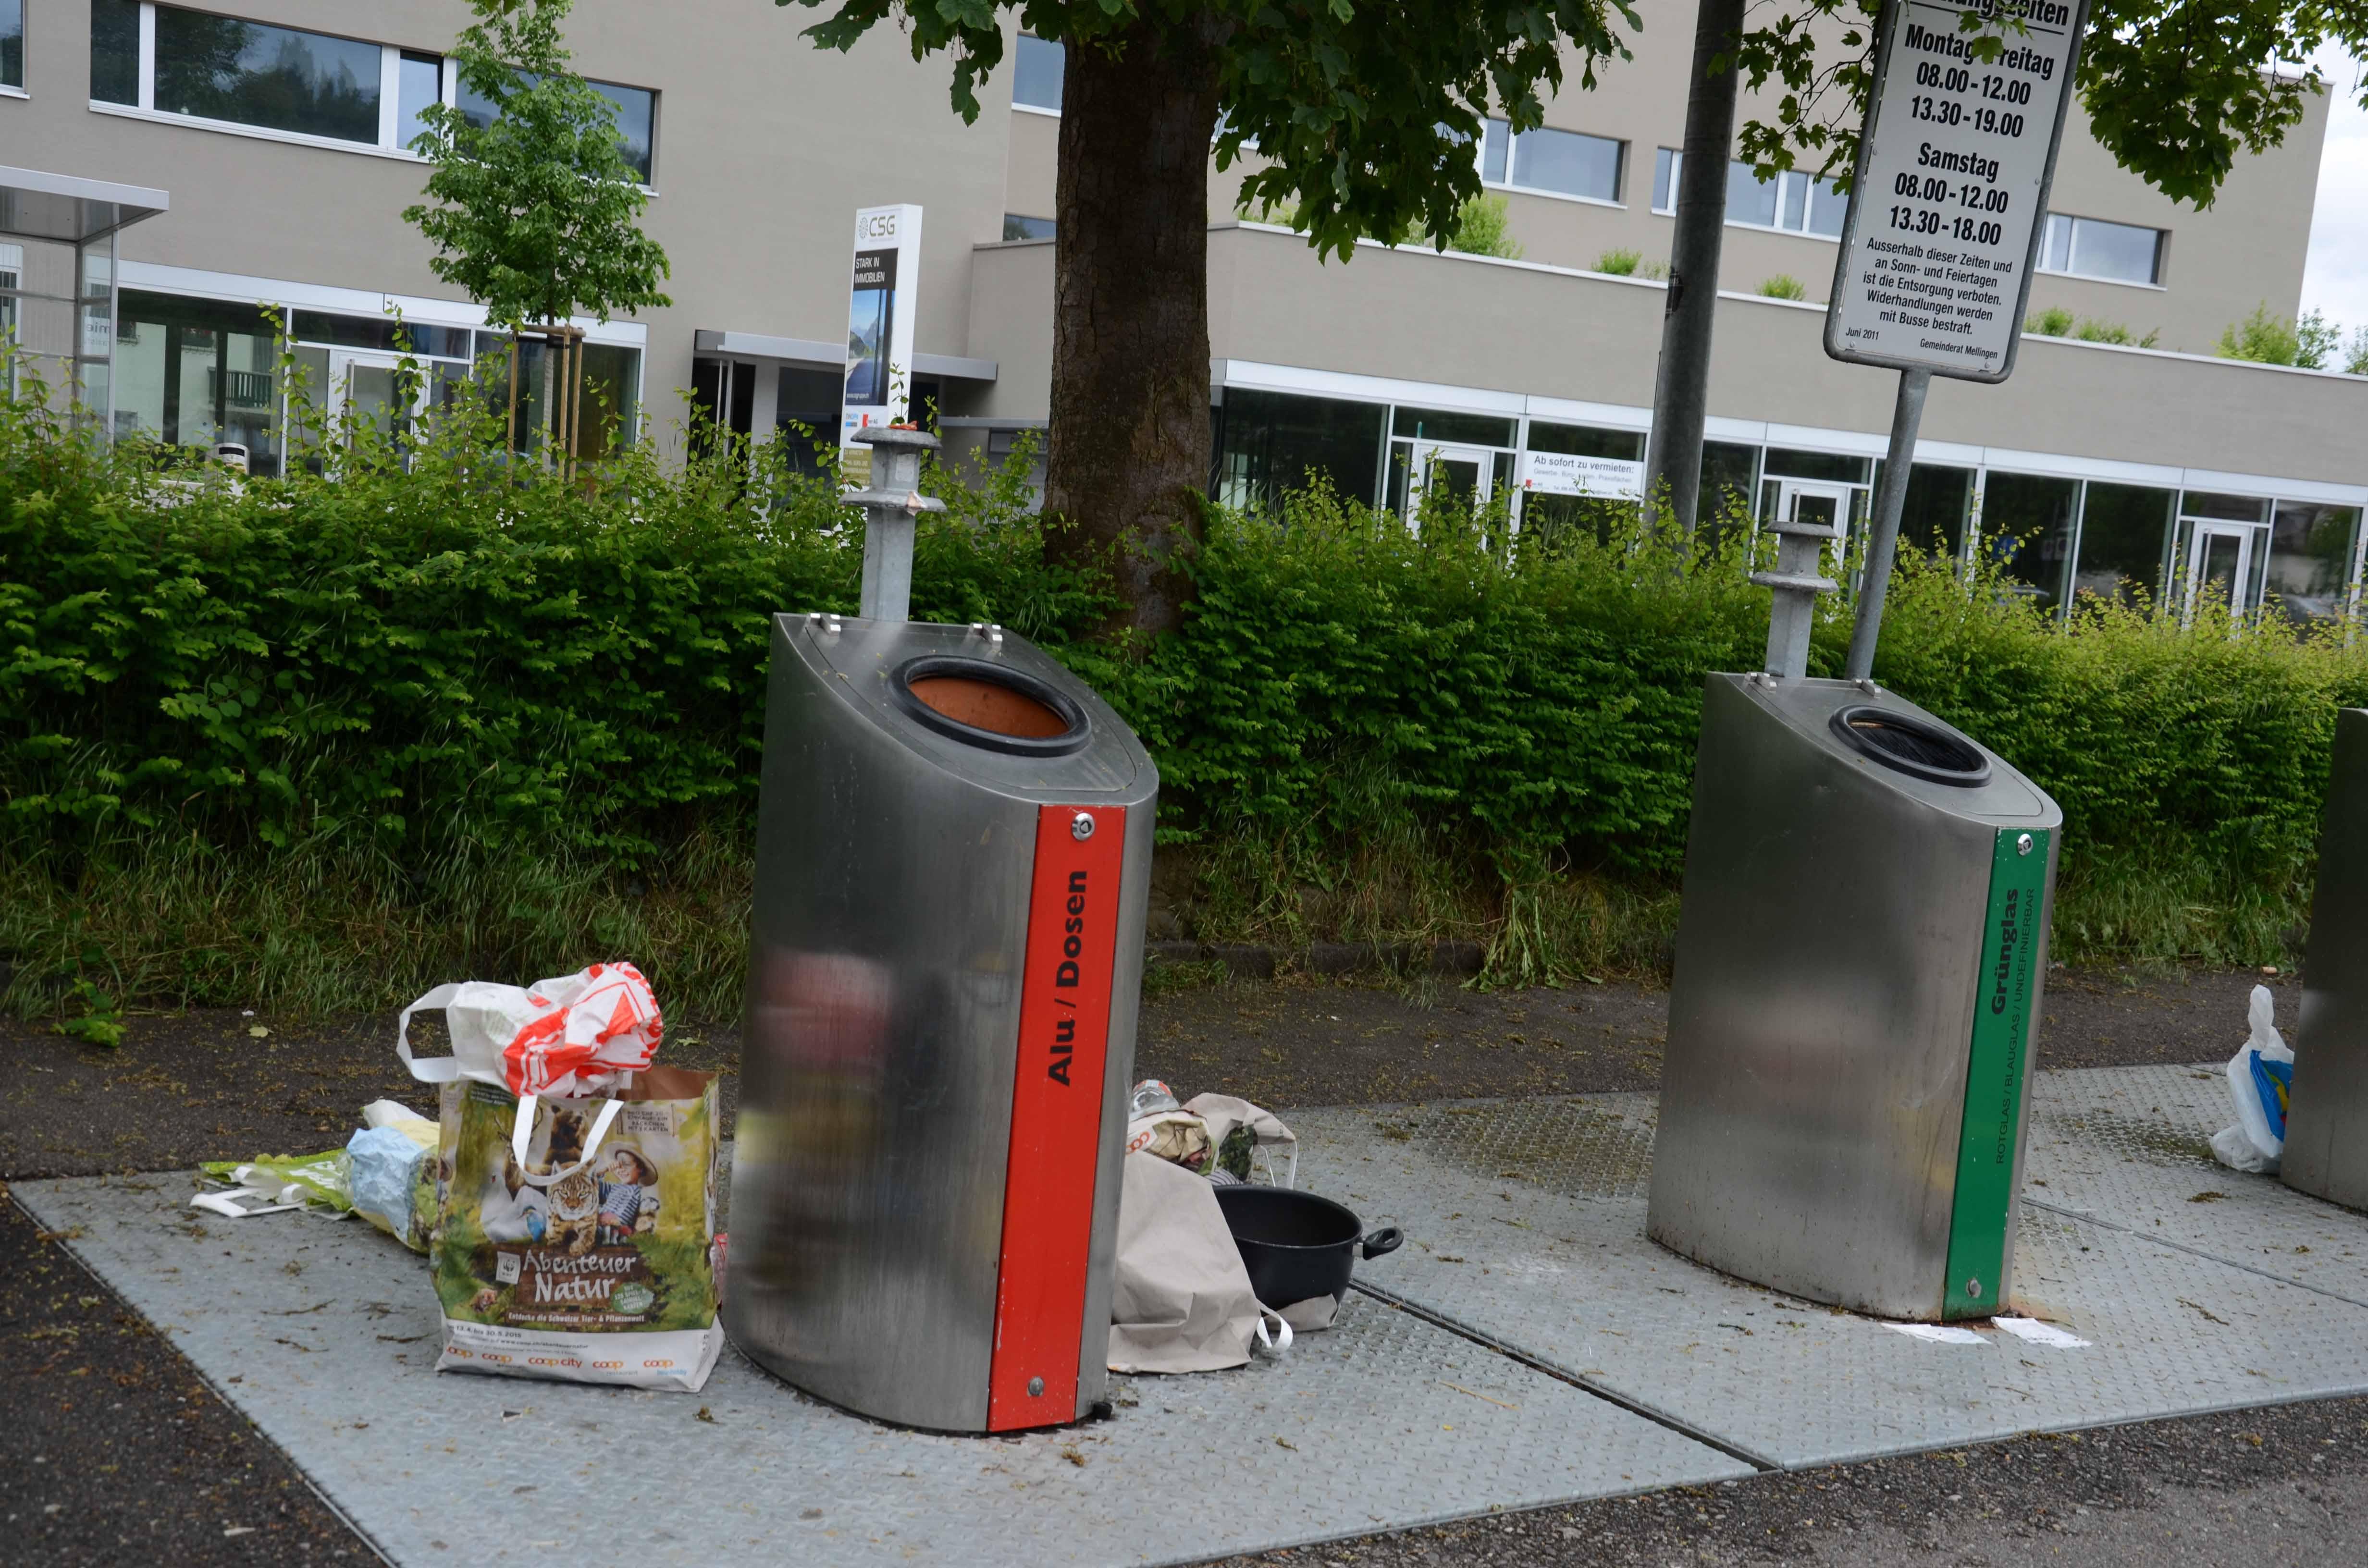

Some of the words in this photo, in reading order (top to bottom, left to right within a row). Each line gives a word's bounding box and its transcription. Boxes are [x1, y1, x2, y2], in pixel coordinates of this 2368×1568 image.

[1905, 24, 1974, 65] Montag
[1990, 47, 2054, 80] reitag
[1918, 142, 1999, 183] Samstag
[869, 215, 895, 237] CSG
[856, 257, 873, 269] STARK
[874, 256, 879, 268] IN
[1867, 237, 1924, 258] Ausserhalb
[1926, 249, 1958, 264] dieser
[1960, 253, 1990, 270] Zeiten
[1993, 260, 2012, 273] und
[855, 271, 885, 283] IMMOBILIEN
[1875, 258, 1887, 269] an
[1891, 259, 1921, 273] Sonn-
[1924, 266, 1942, 279] und
[1946, 268, 1998, 288] Feiertagen
[1863, 271, 1876, 284] ist
[1879, 275, 1894, 287] die
[1897, 276, 1954, 300] Entsorgung
[1957, 290, 2002, 306] verboten.
[1867, 289, 1953, 315] Widerhandlungen
[1957, 306, 1993, 321] werden
[1846, 327, 1862, 338] Juni
[1863, 329, 1879, 340] 2011
[1879, 310, 1896, 322] mit
[1899, 313, 1929, 328] Busse
[1932, 318, 1973, 335] bestraft.
[1920, 339, 1963, 354] Gemeinderat
[1965, 345, 1998, 359] Mellingen
[1534, 456, 1546, 465] Ab
[1549, 457, 1574, 468] sofort
[1590, 463, 1634, 473] vermieten:
[1056, 870, 1088, 988] Dosen
[1991, 889, 2018, 1015] Grünglas
[1996, 1098, 2010, 1164] ROTGLAS
[2004, 1014, 2021, 1086] BLAUGLAS
[2014, 888, 2035, 1002] UNDEFINIERBAR
[1048, 1019, 1076, 1087] Alu
[523, 1249, 636, 1273] Abenteuer
[535, 1273, 616, 1302] Natur
[509, 1312, 535, 1321] Entdecke
[605, 1314, 644, 1323] Pflanzenwelt
[482, 1353, 512, 1363] coop
[529, 1357, 559, 1368] coop
[561, 1358, 582, 1369] city
[593, 1360, 623, 1371] coop
[643, 1360, 674, 1369] coop
